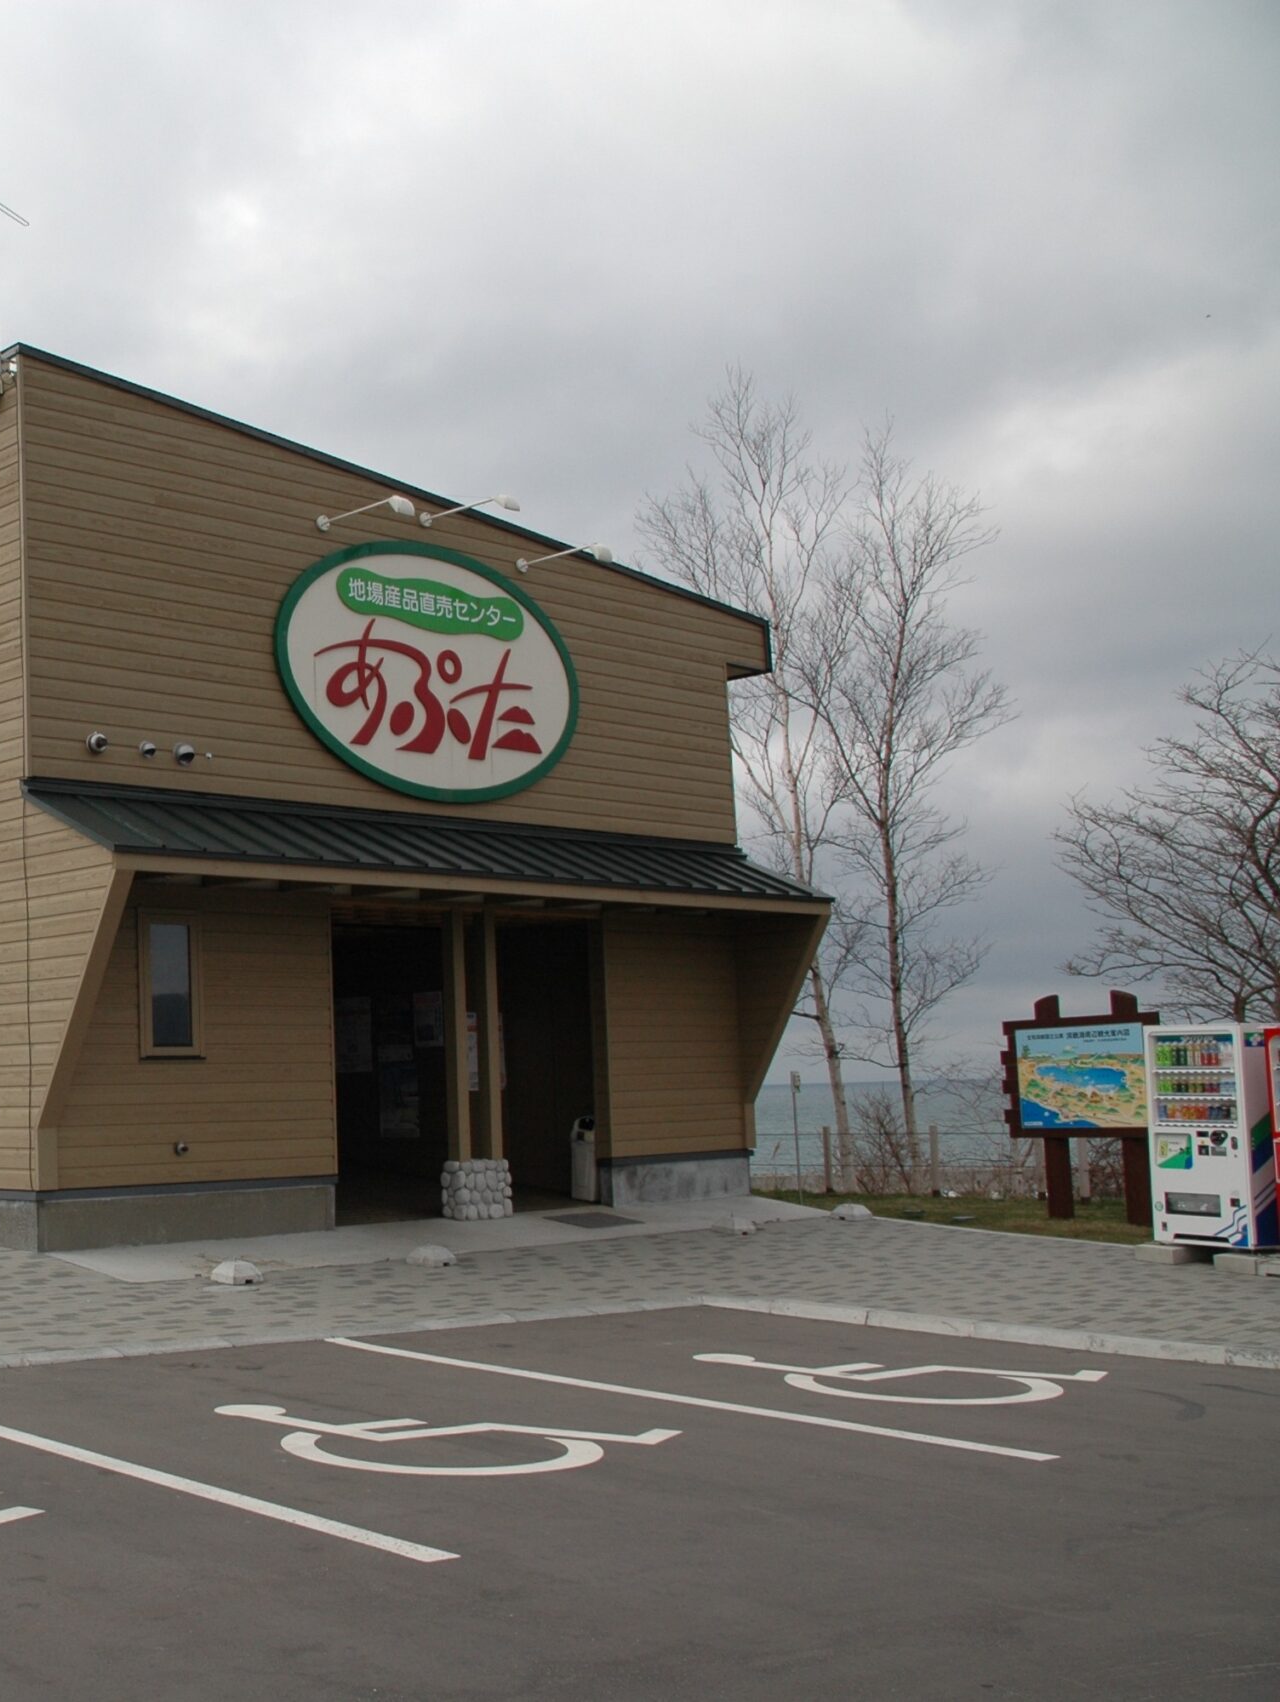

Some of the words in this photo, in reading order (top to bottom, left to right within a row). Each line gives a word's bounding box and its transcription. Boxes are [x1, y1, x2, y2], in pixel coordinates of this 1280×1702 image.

[348, 577, 516, 626] 地場産品直売センター
[313, 618, 544, 761] あぷた
